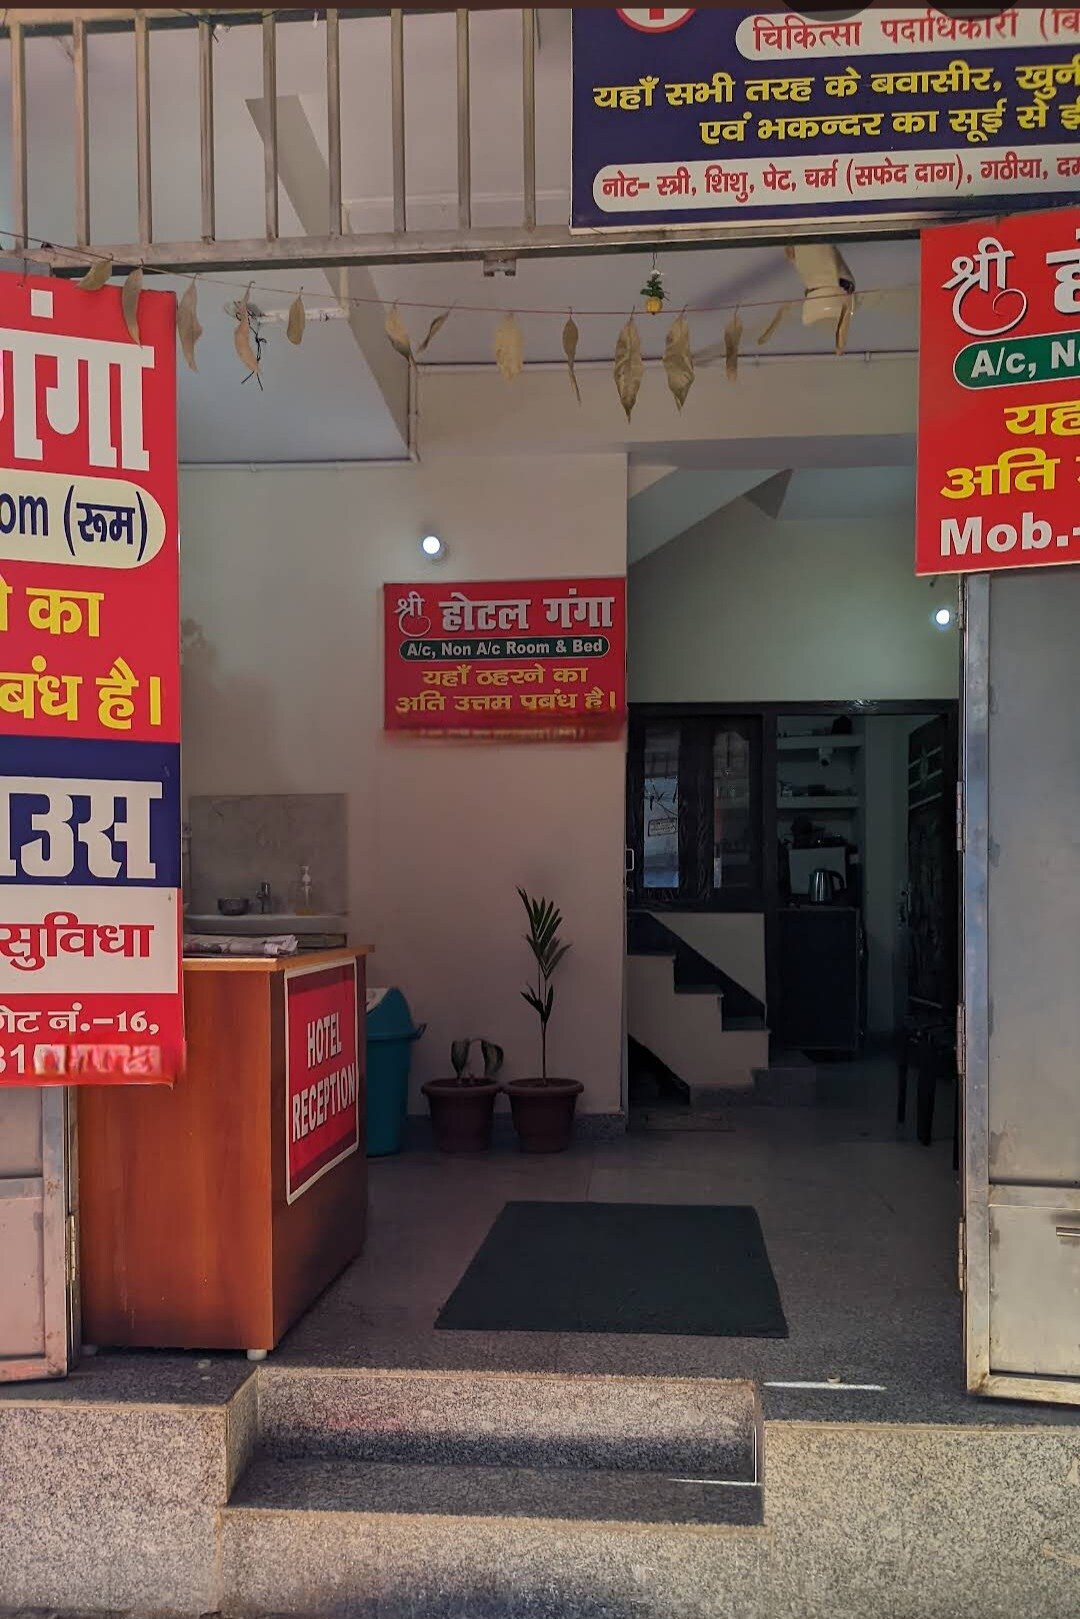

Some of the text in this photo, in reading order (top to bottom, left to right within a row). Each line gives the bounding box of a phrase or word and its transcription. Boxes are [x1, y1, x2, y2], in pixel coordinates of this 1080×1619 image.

[752, 15, 862, 51] चिकित्सा
[593, 75, 660, 110] यहाँ
[665, 72, 736, 106] सभी
[745, 76, 815, 101] तरह
[824, 66, 862, 97] के
[870, 60, 1002, 95] बवासीर,
[699, 111, 753, 145] एवं
[757, 112, 884, 141] भकन्दर
[892, 111, 939, 133] का
[949, 99, 1007, 143] सूई
[1016, 97, 1050, 130] से
[602, 170, 650, 198] नोट-
[657, 166, 697, 196] स्त्री,
[705, 164, 755, 203] शिशु,
[763, 163, 797, 192] पेट,
[805, 159, 839, 188] चर्म
[846, 158, 909, 195] (सफेद
[980, 151, 1049, 180] गठीया,
[941, 236, 1027, 337] श्री
[970, 347, 1037, 379] A/c,
[939, 447, 1061, 500] अति
[63, 484, 148, 562] (रूम)
[25, 586, 105, 637] का
[394, 588, 616, 637] श्री होटल गंगा
[406, 637, 603, 660] A/c, Non A/c Room & Bed
[422, 664, 588, 687] यहाँ ठहरने का
[395, 690, 447, 713] अति
[453, 695, 512, 712] उत्तम
[0, 911, 155, 971] सुविधा
[307, 1011, 342, 1069] HOTEL
[292, 1062, 356, 1143] RECEPTION
